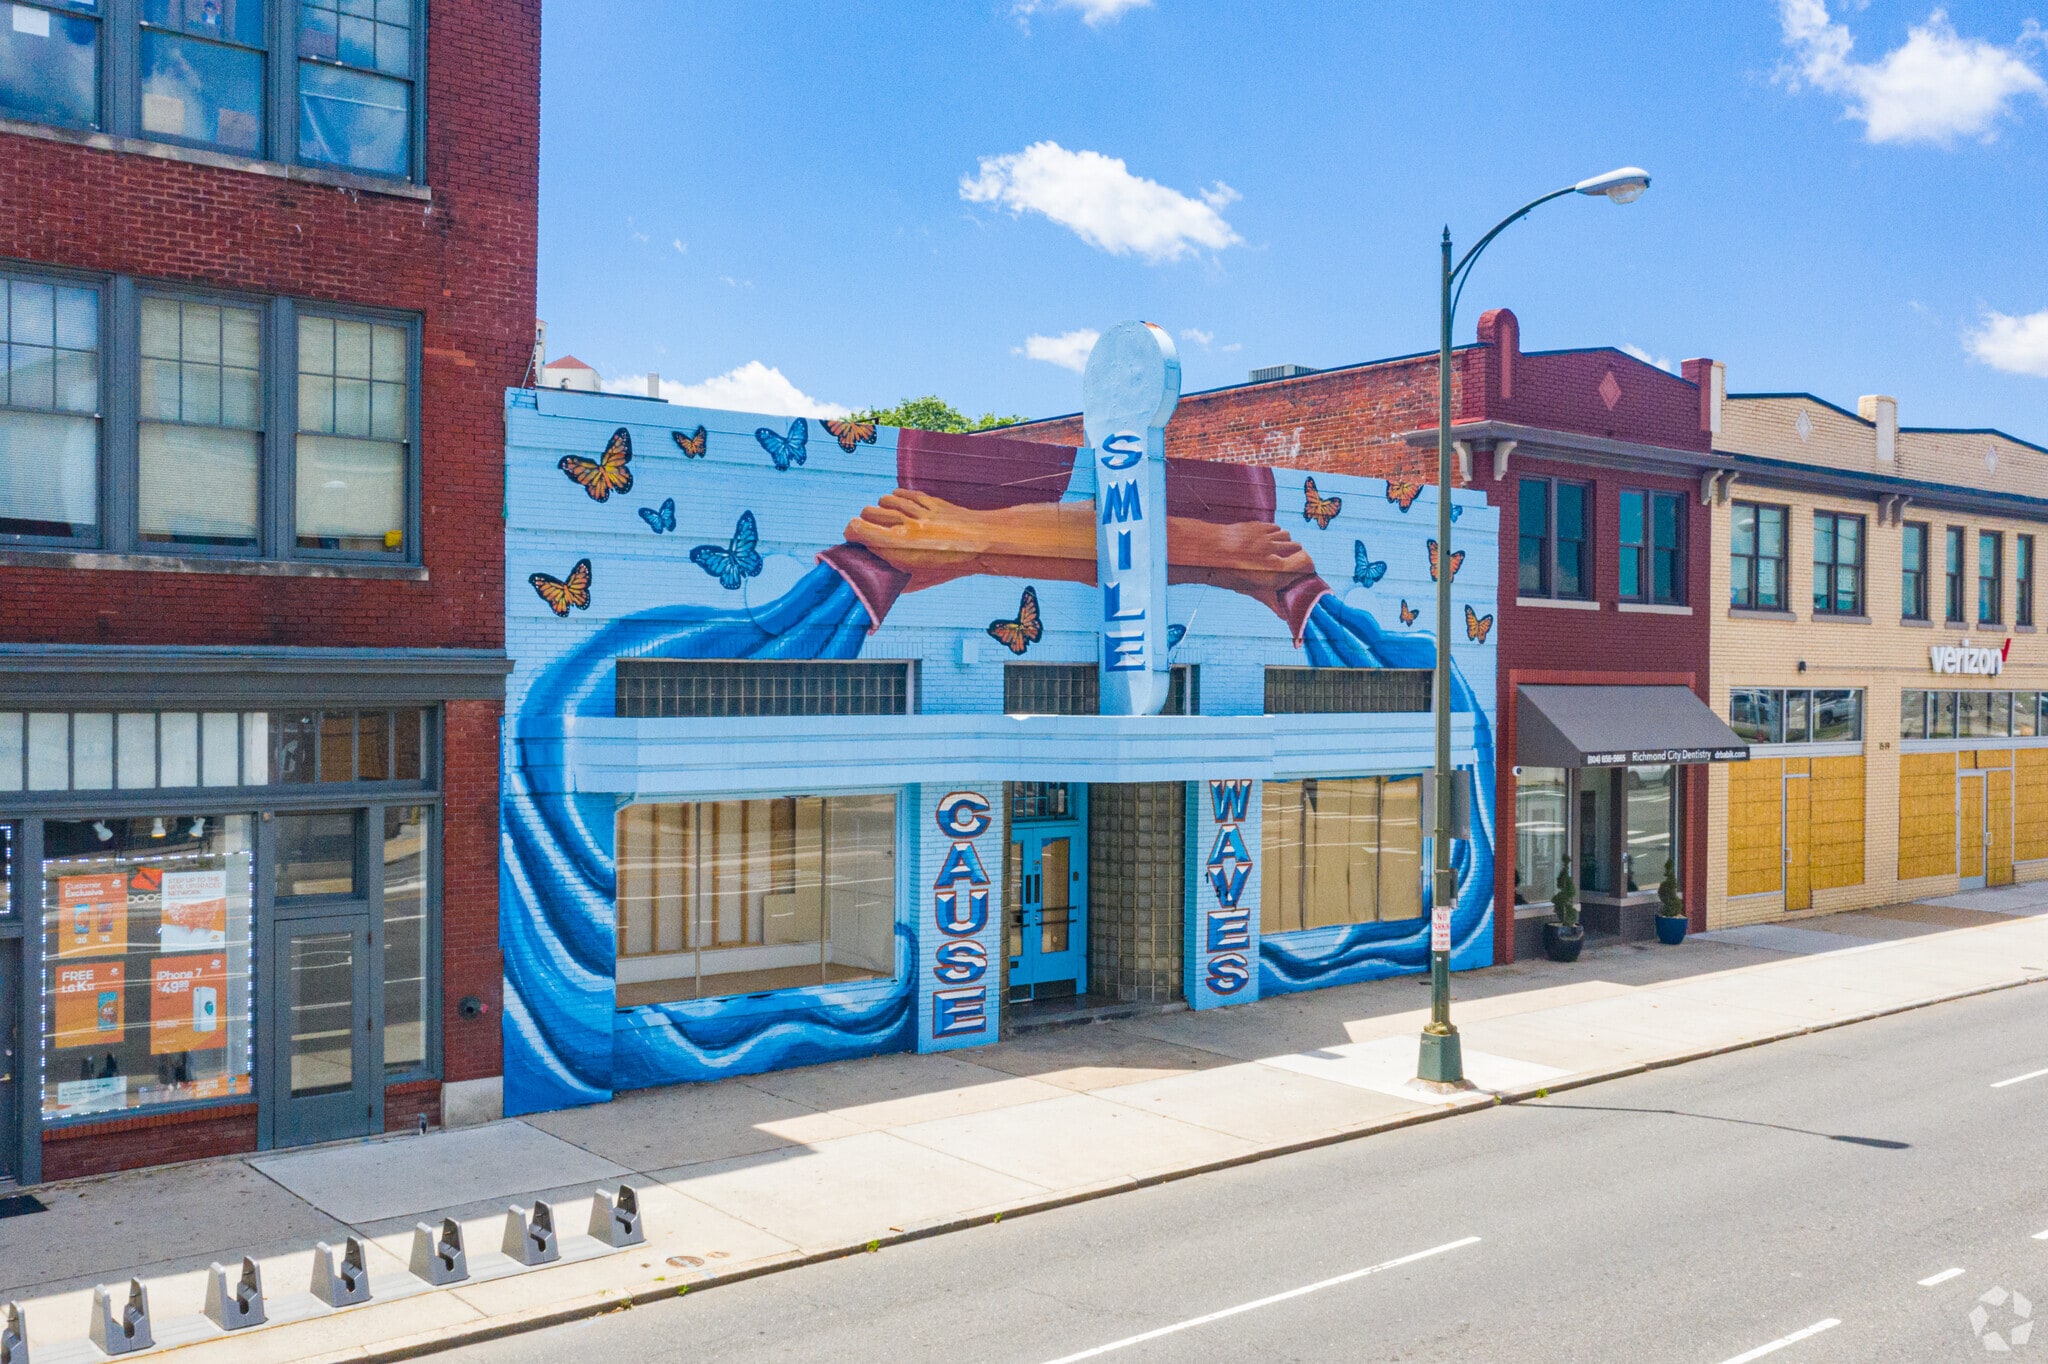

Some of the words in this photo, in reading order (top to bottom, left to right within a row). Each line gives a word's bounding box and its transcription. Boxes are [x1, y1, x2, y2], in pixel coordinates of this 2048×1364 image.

[1101, 430, 1146, 673] SMILE
[1930, 639, 2003, 675] verizon
[1632, 750, 1666, 762] Richmond
[1667, 749, 1681, 762] City
[1682, 749, 1711, 761] Dentistry
[65, 882, 101, 890] Customer
[1206, 779, 1253, 996] WAVES
[65, 889, 104, 898] Exclusive
[933, 791, 992, 1040] CAUSE
[1437, 913, 1448, 921] NO
[62, 969, 94, 982] FREE
[156, 970, 193, 981] iPhone
[195, 967, 203, 978] 7
[62, 984, 75, 993] LG
